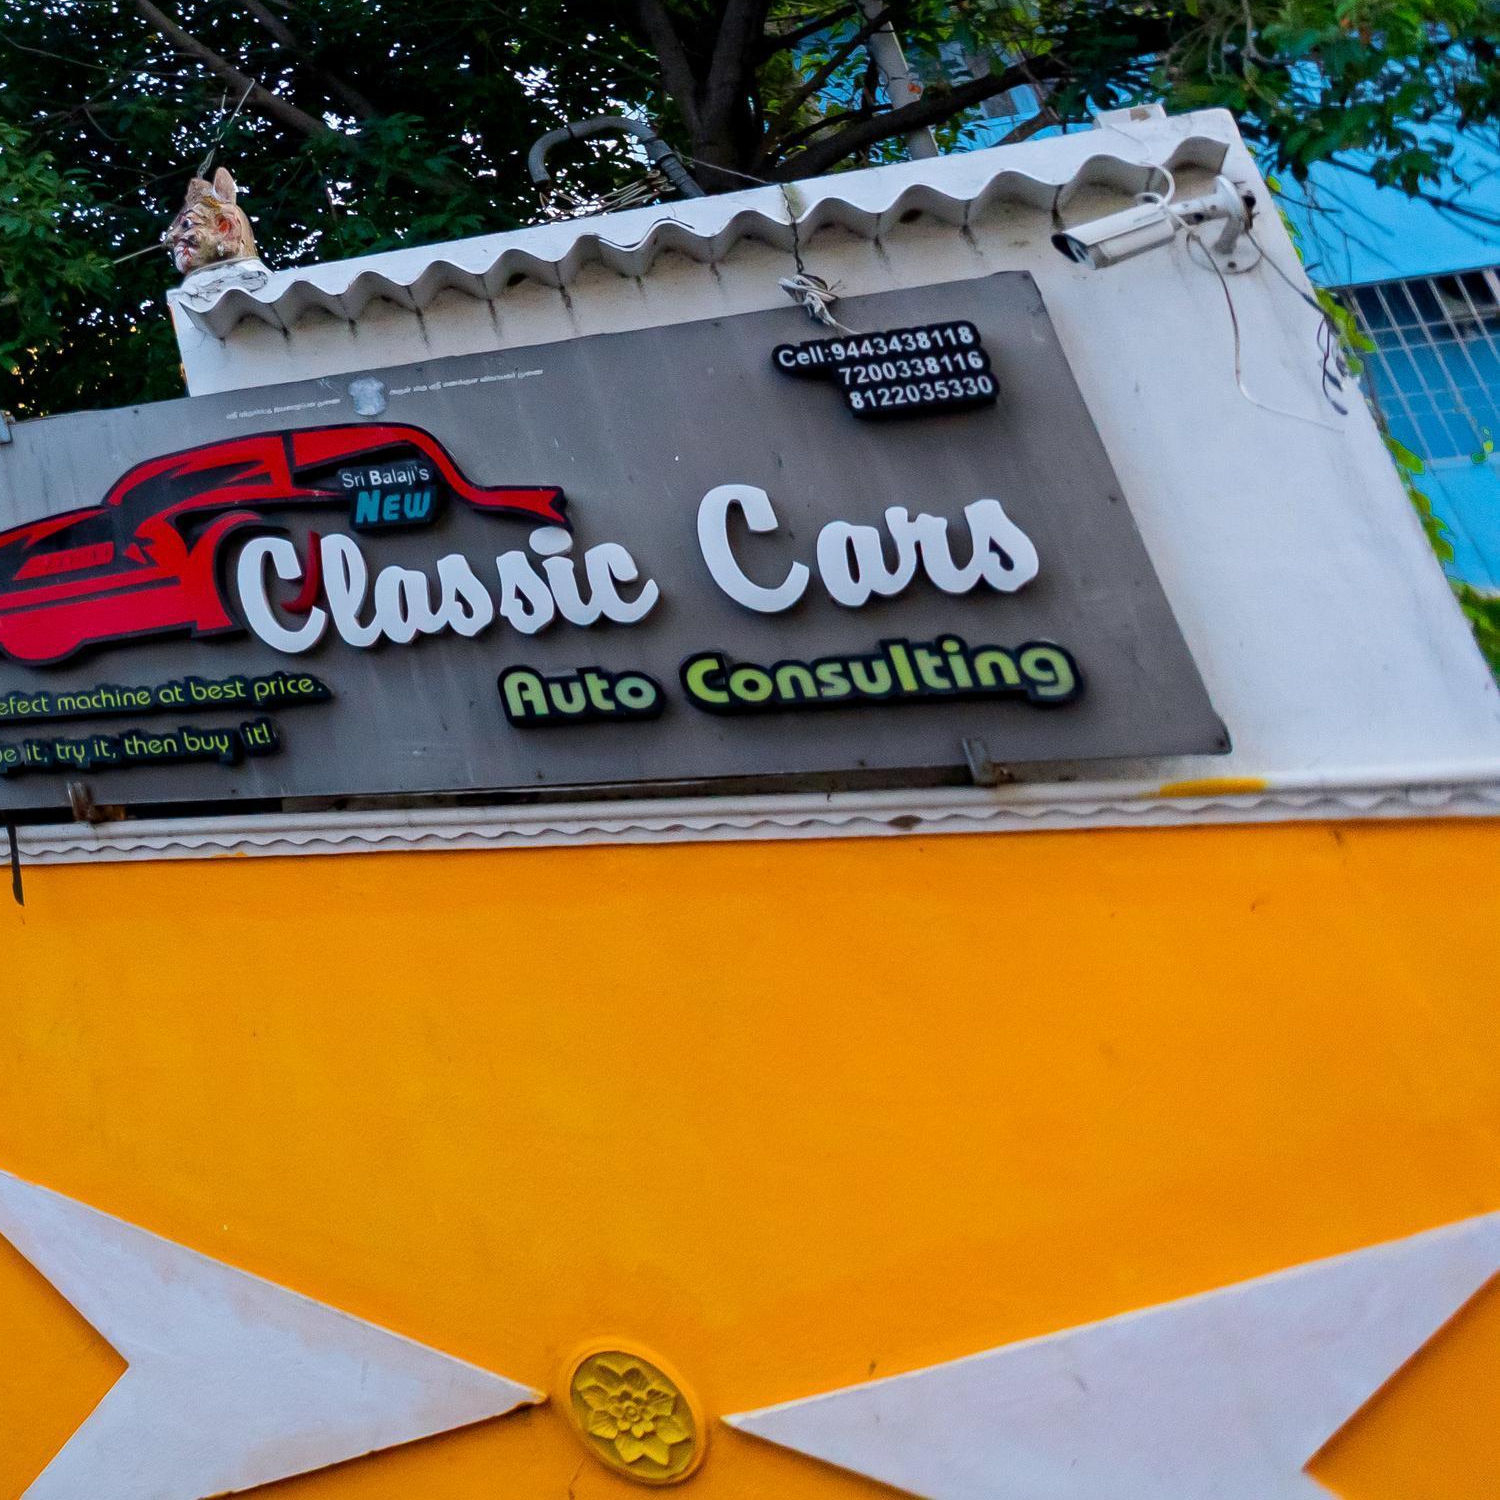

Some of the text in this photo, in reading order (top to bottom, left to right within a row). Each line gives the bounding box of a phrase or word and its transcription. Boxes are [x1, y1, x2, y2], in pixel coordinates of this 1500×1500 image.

[778, 326, 974, 367] Cell:9443438118
[839, 351, 983, 385] 7200338116
[850, 375, 993, 410] 8122035330
[342, 465, 431, 488] Sri Balaji's
[237, 484, 1039, 653] Classic Cars
[57, 688, 150, 712] machine
[159, 685, 185, 703] at
[190, 677, 246, 700] best
[253, 674, 324, 701] price.
[503, 639, 1076, 717] Auto Consulting
[55, 742, 85, 764] try
[93, 739, 117, 758] it,
[124, 734, 177, 756] then
[184, 730, 229, 753] buy
[245, 722, 272, 747] it!
